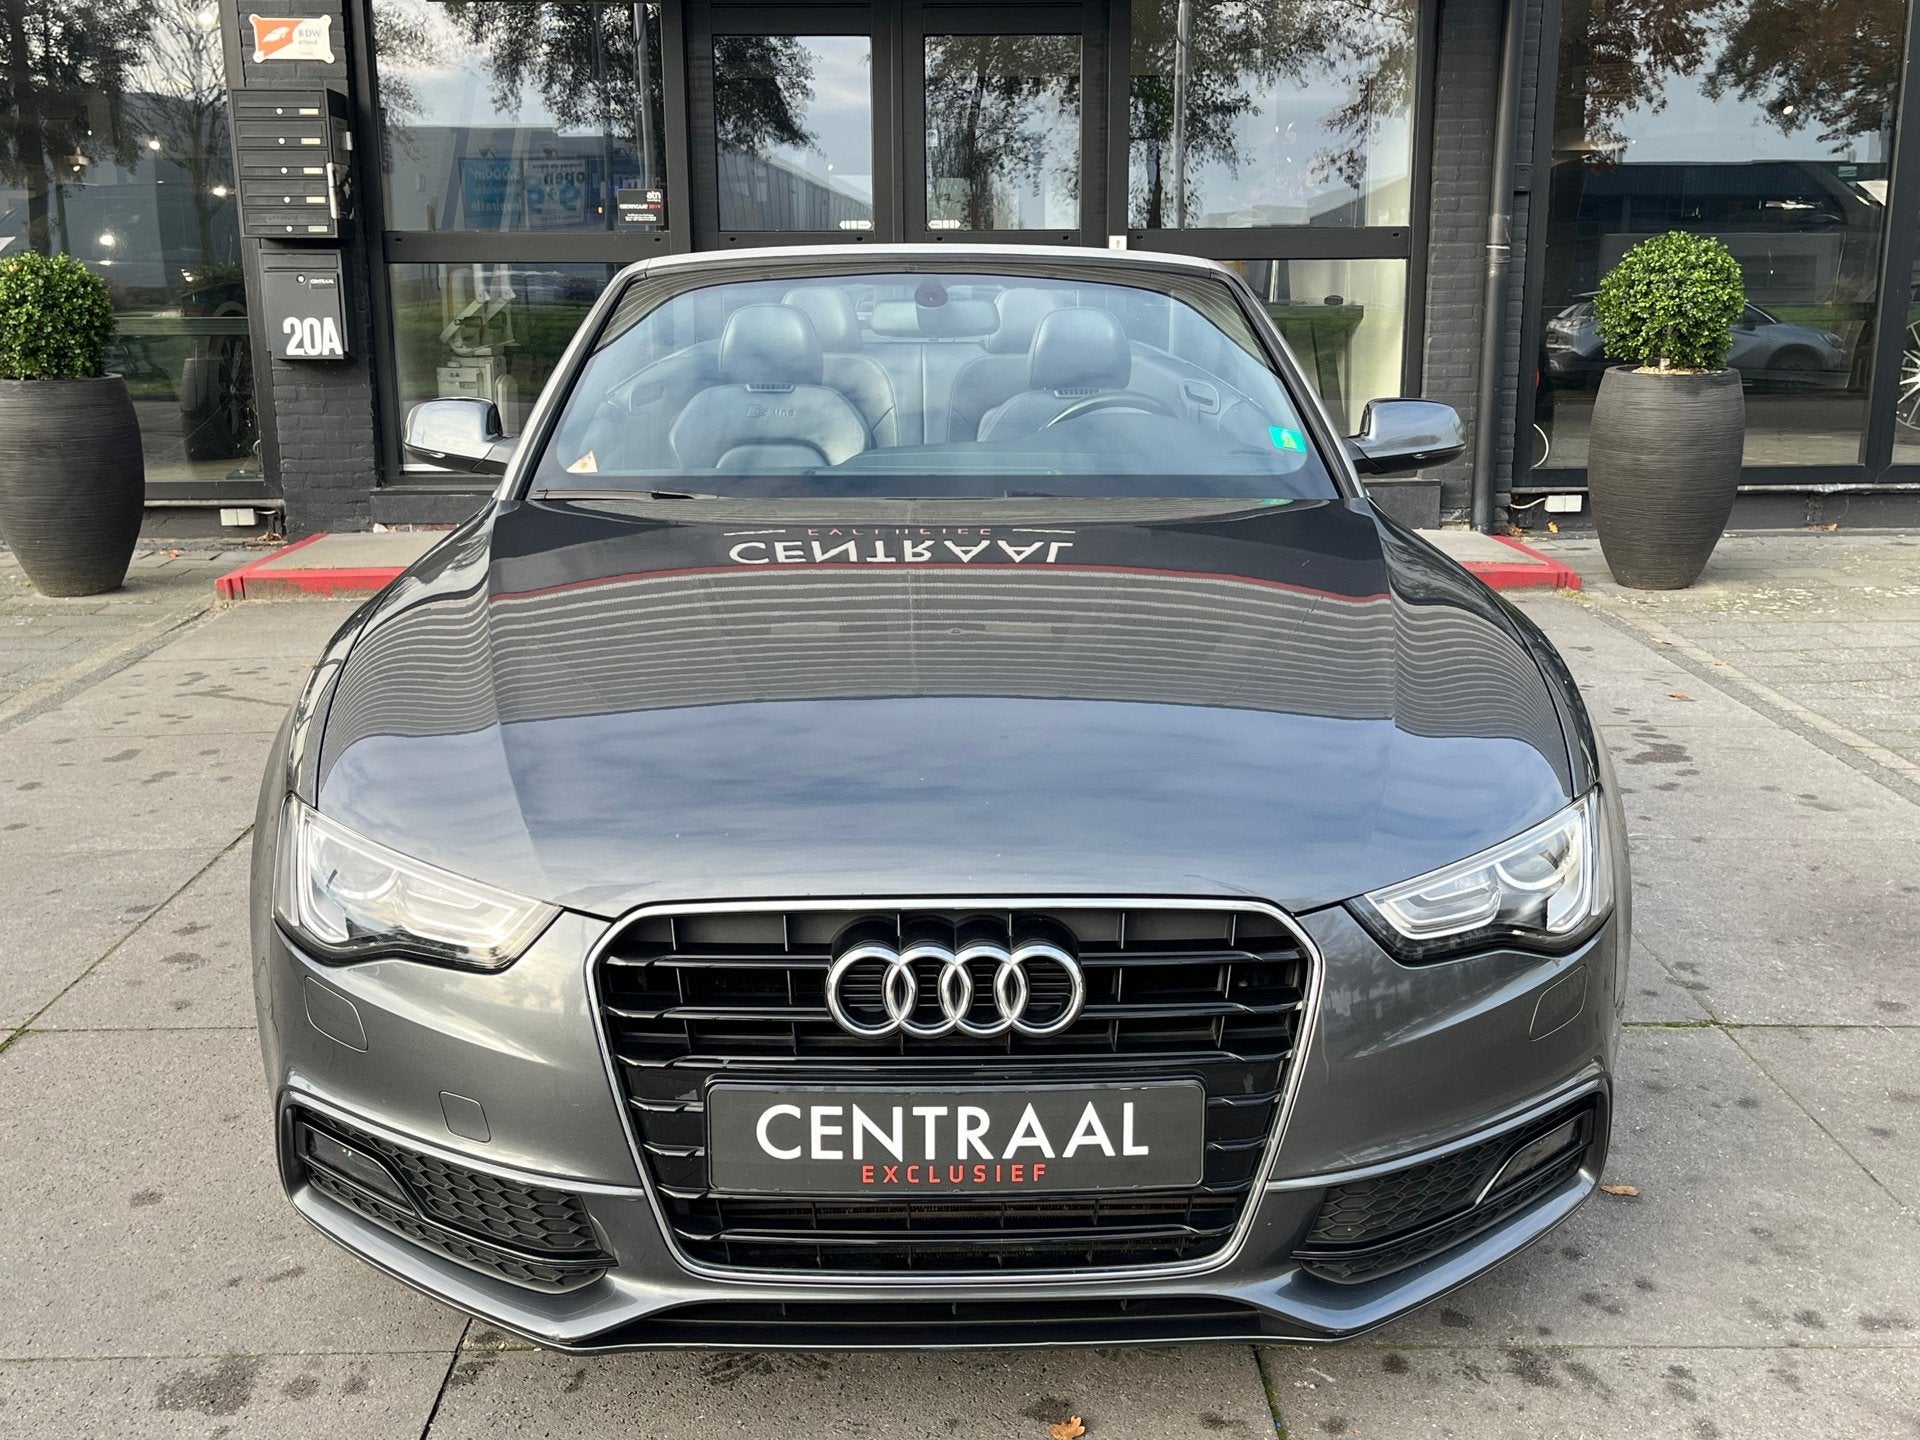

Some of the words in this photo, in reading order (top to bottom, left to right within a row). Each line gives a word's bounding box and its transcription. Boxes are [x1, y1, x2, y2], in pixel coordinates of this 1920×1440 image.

[298, 28, 321, 37] RDW
[283, 316, 343, 356] 20A
[755, 1101, 1149, 1162] CENTRAAL
[861, 1163, 1047, 1185] EXCLUSIEF
